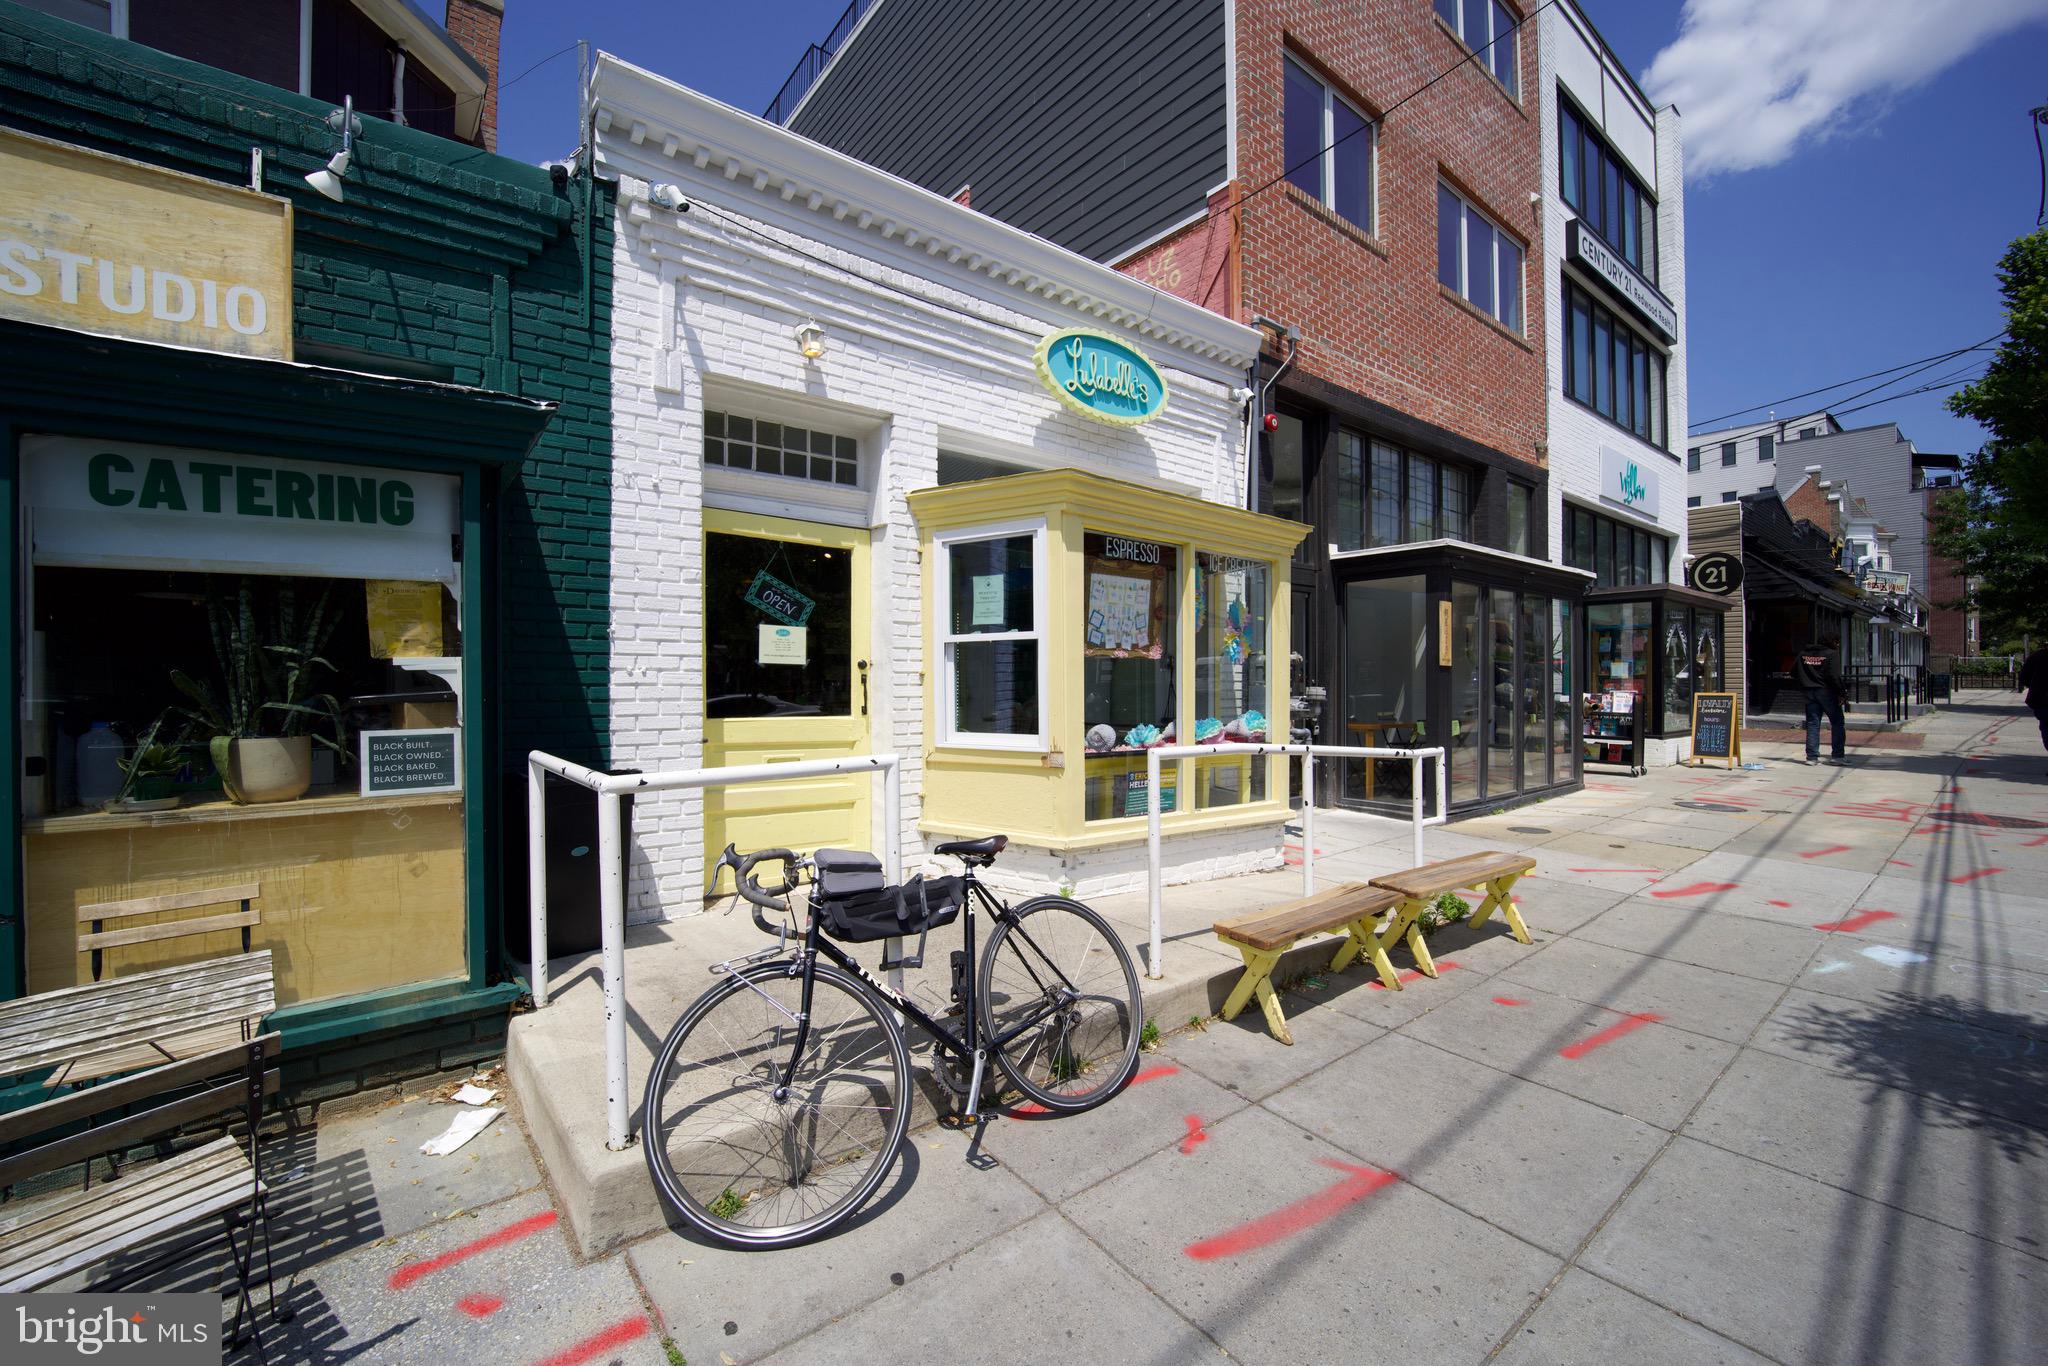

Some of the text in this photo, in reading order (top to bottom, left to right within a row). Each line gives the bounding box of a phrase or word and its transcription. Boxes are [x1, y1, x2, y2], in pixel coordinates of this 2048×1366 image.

[0, 240, 267, 336] STUDIO
[1581, 236, 1673, 333] CENTURY 21 Redwood Realty
[1065, 337, 1149, 403] Lulabelle's
[88, 452, 415, 527] CATERING
[1105, 536, 1160, 565] ESPRESSO
[1209, 554, 1223, 573] ICE
[1705, 565, 1727, 584] 21
[762, 590, 798, 616] OPEN
[373, 743, 403, 751] BLACK
[373, 752, 445, 762] BLACK OWNED.
[373, 763, 438, 773] BLACK BAKED.
[373, 773, 447, 784] BLACK BREWED.
[858, 964, 904, 1006] TREK
